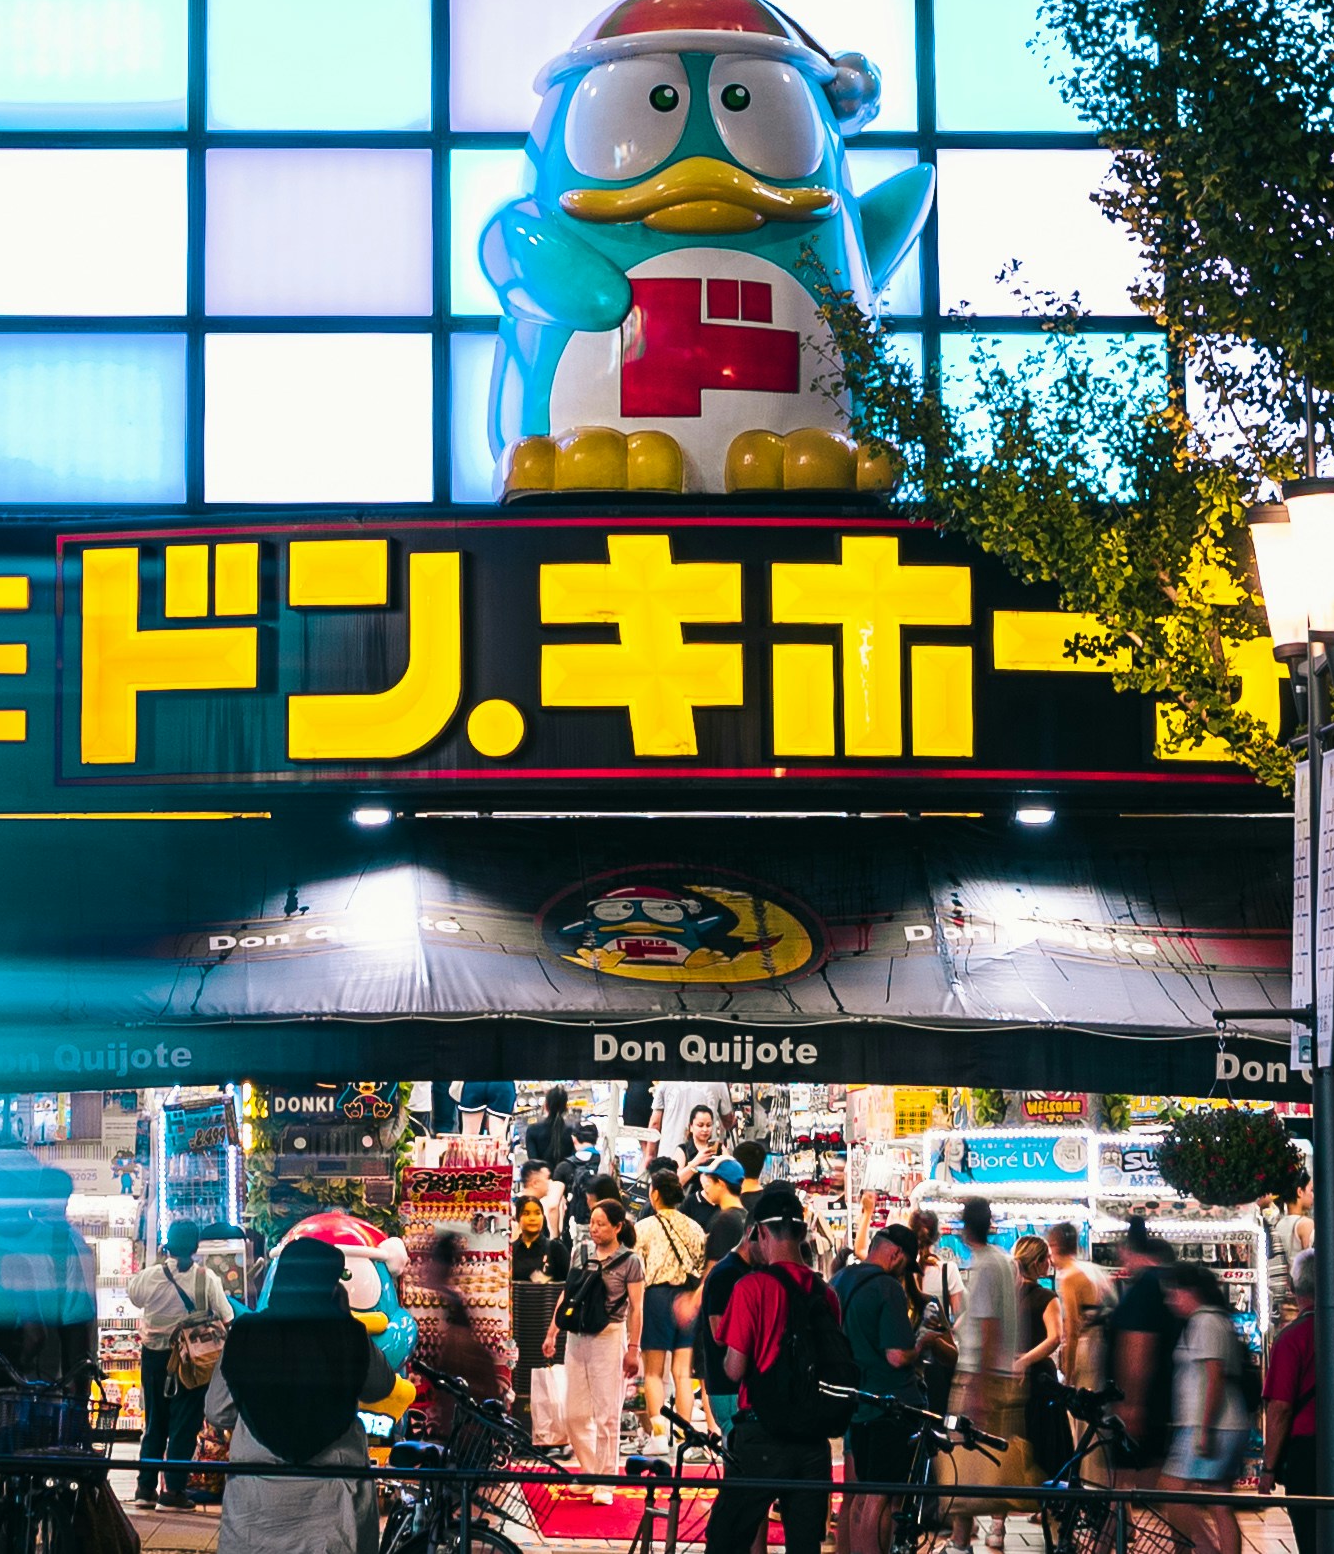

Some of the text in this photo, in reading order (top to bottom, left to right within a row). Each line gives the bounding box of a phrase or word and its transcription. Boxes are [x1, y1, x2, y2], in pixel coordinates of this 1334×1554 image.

[209, 932, 291, 951] Don
[904, 924, 991, 942] Don
[54, 1041, 193, 1077] Quijote
[593, 1034, 818, 1071] Don Quijote
[1216, 1052, 1287, 1083] Don
[274, 1096, 335, 1113] DONKI
[1025, 1100, 1083, 1115] WELCOME
[967, 1150, 1050, 1171] Bioré UV
[1223, 1270, 1255, 1280] 699
